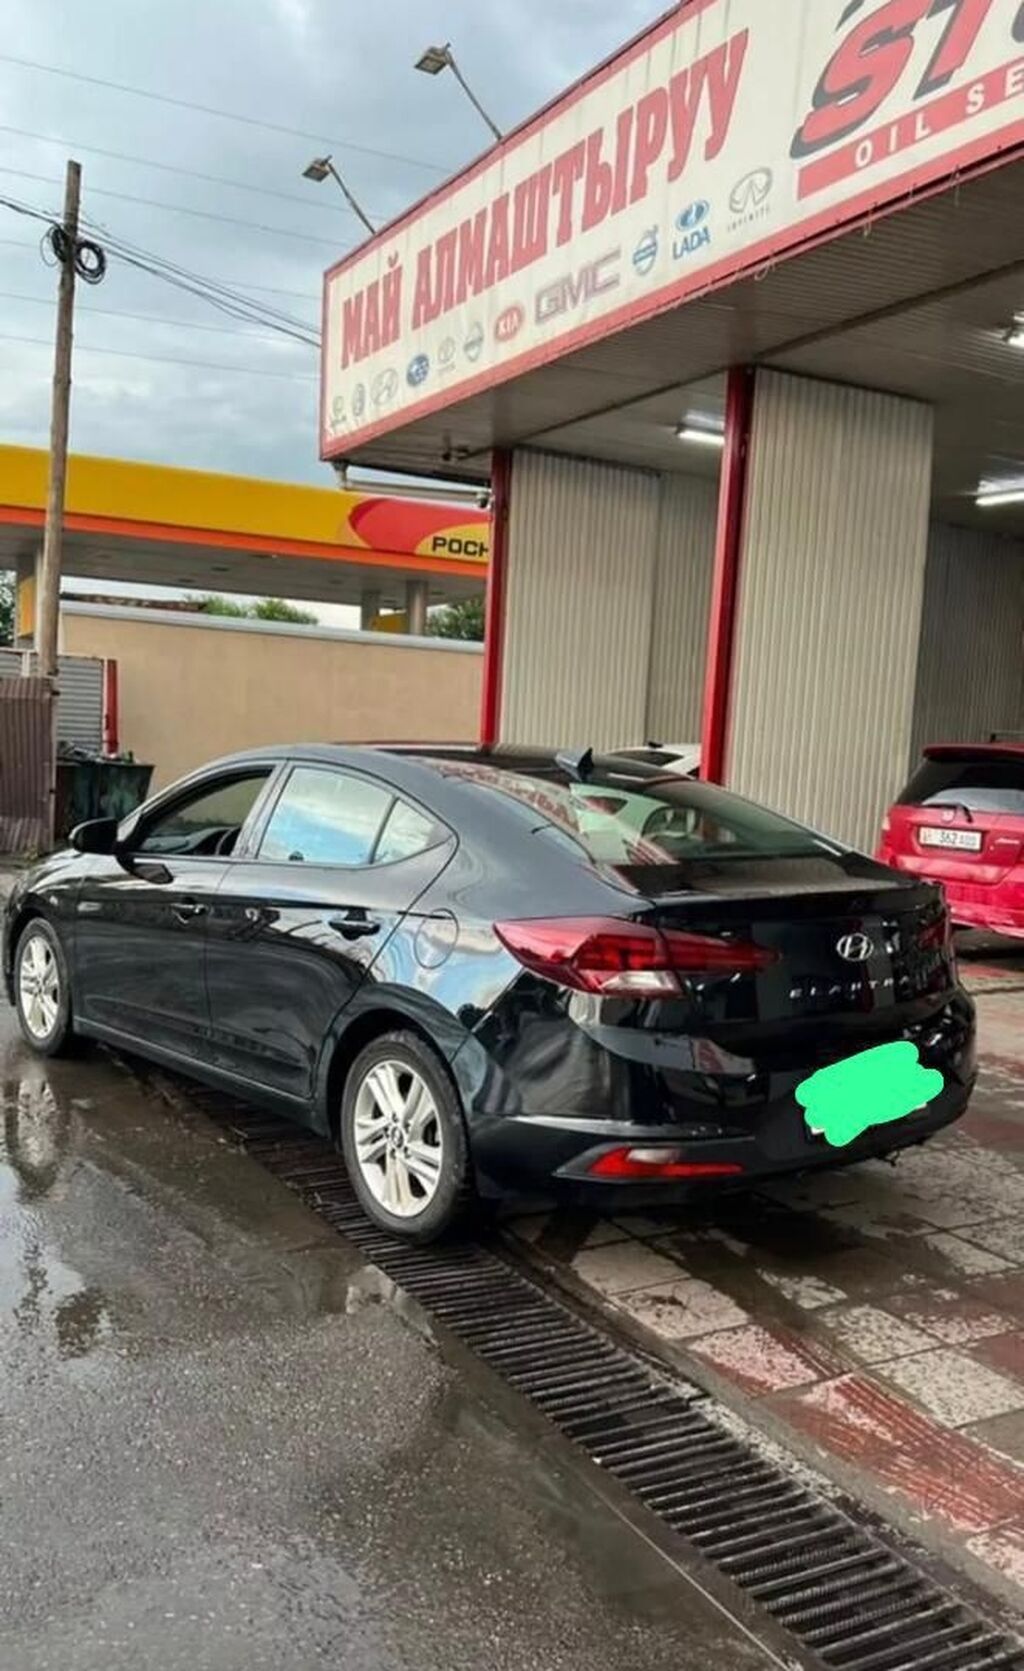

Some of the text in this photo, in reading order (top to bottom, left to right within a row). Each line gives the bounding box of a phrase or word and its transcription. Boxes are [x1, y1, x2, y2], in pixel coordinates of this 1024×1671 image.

[855, 112, 931, 168] OIL
[341, 28, 749, 370] МАЙ АЛМАШТЫРУУ
[672, 226, 711, 260] LADA
[535, 246, 621, 324] GMC
[499, 311, 519, 333] KIA
